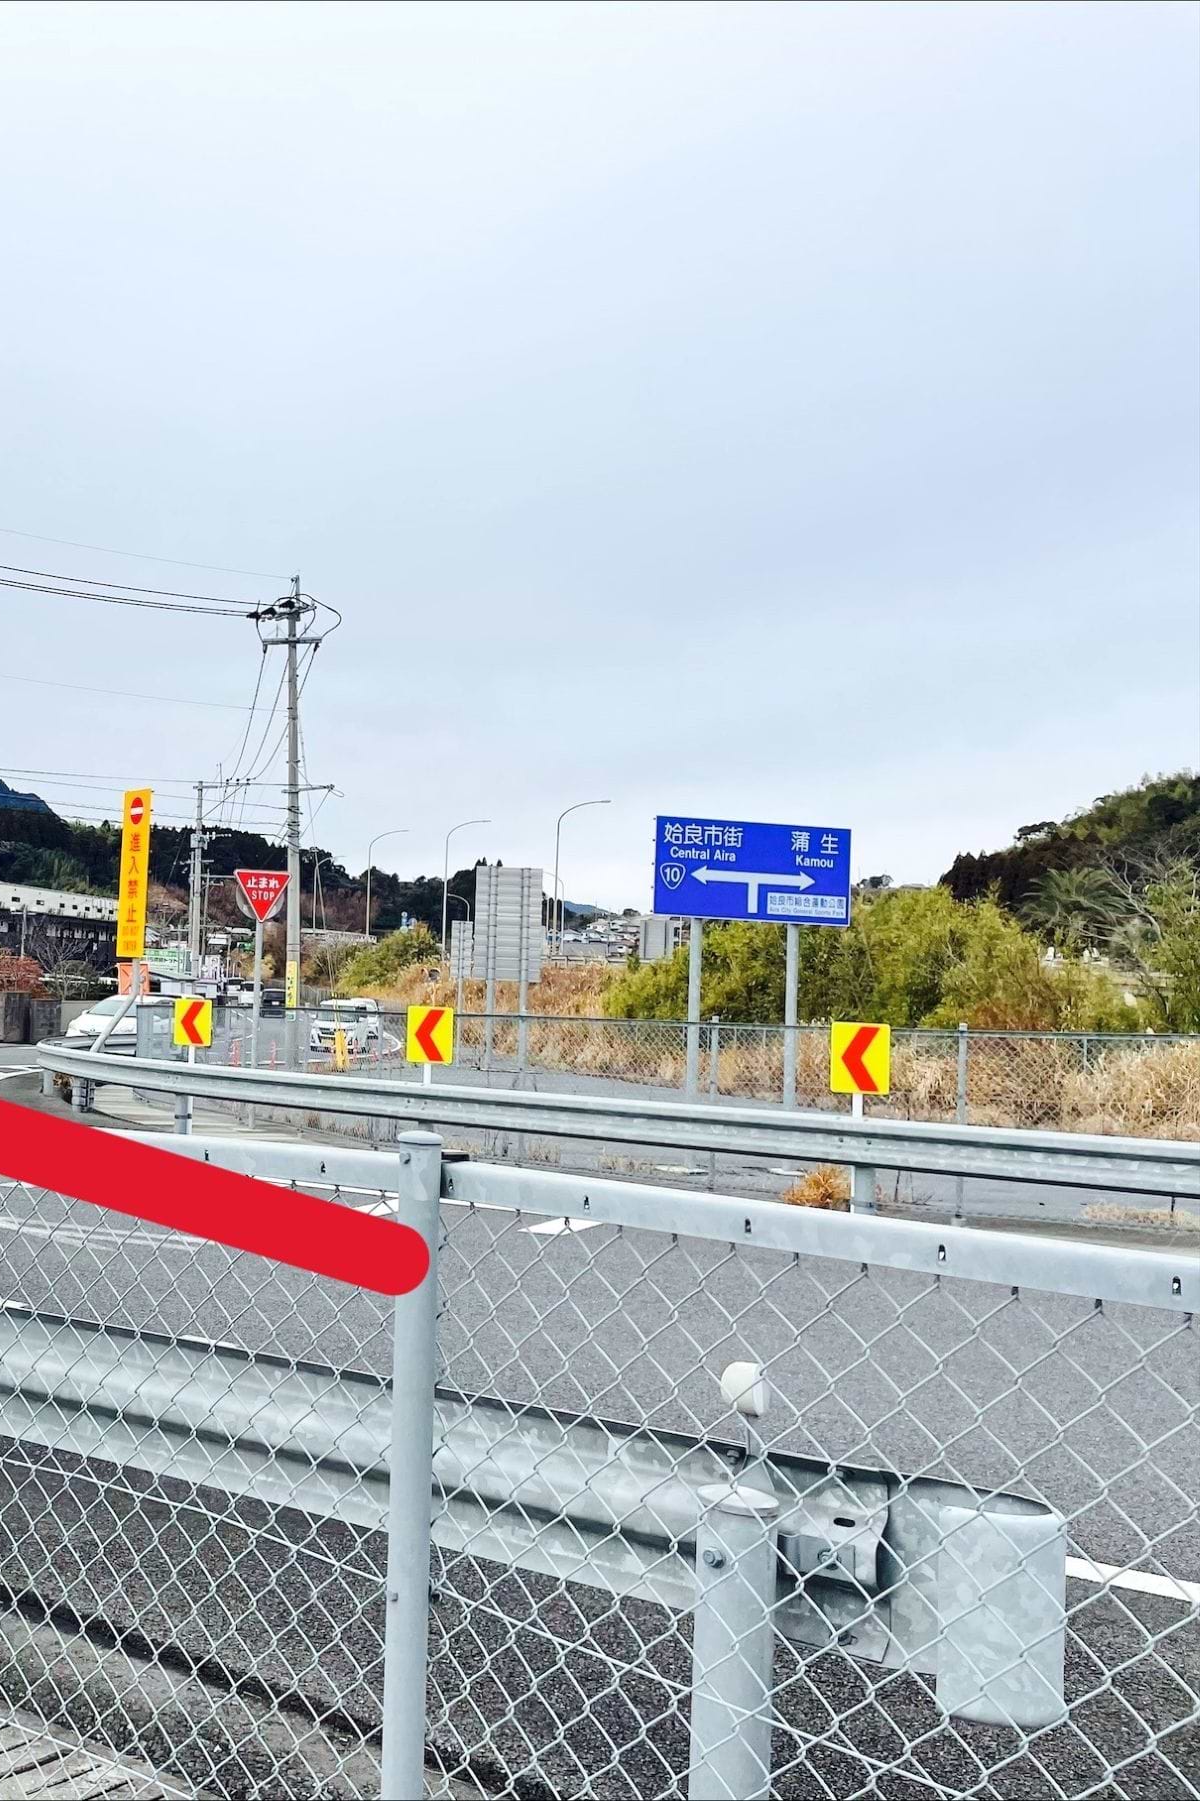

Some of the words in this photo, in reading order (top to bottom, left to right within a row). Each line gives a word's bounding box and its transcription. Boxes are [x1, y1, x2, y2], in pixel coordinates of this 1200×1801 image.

[664, 822, 743, 848] 姶良市街
[670, 846, 710, 861] Central
[714, 850, 736, 862] Aira
[796, 855, 834, 868] Kamou
[125, 833, 141, 923] 進入禁止
[246, 876, 280, 889] 止まれ
[664, 867, 681, 883] 10
[251, 890, 275, 901] STOP
